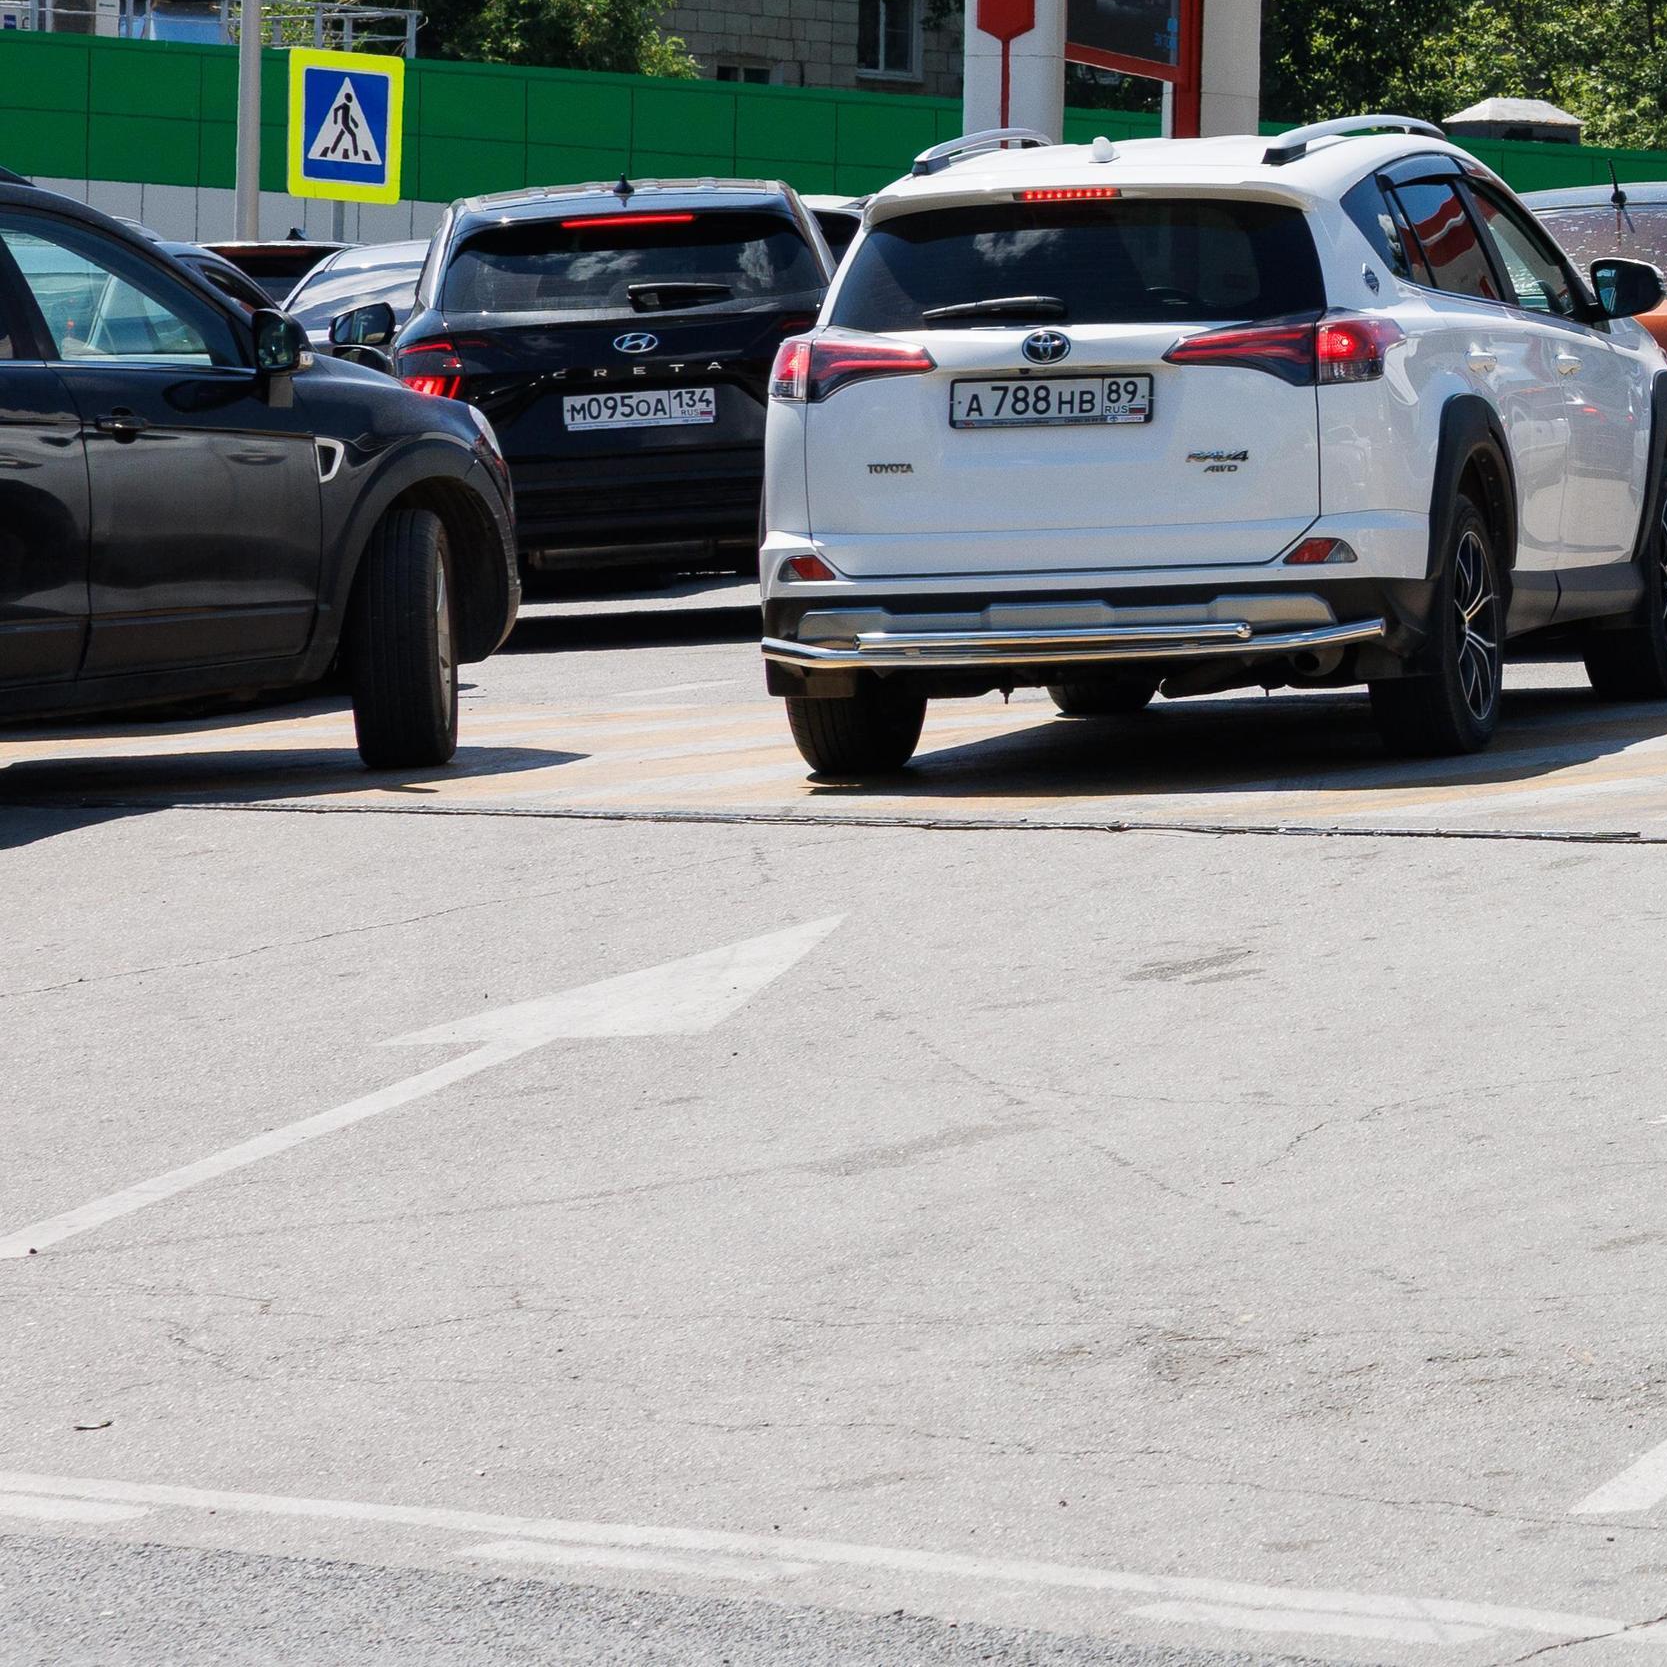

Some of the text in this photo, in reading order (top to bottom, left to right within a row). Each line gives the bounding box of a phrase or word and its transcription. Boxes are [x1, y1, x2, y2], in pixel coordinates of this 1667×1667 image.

[552, 362, 722, 380] CRETA
[570, 390, 713, 422] М095ОА 134
[965, 381, 1138, 417] А788НВ 89
[1105, 405, 1128, 414] RUS
[867, 463, 914, 474] TOYOTA
[1203, 464, 1238, 473] AWD
